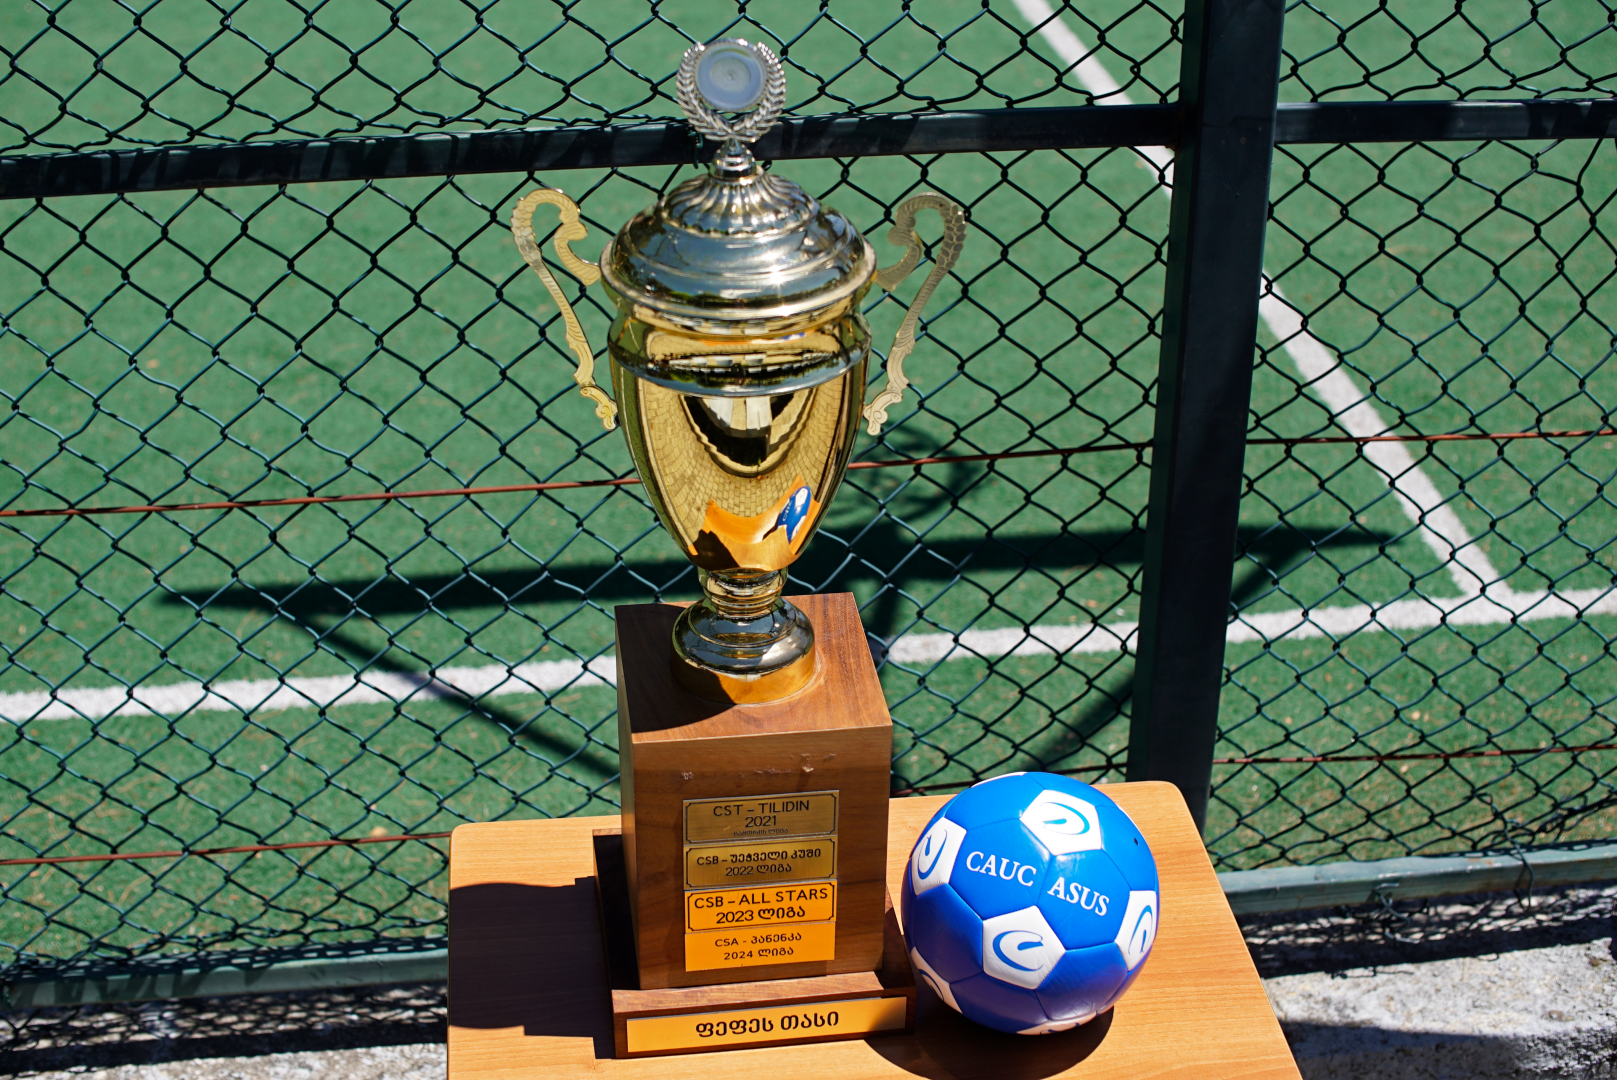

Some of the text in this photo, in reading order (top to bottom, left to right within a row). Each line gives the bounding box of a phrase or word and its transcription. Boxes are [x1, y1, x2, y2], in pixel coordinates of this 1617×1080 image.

[713, 804, 743, 816] CST
[758, 800, 810, 814] TILIDIN
[745, 815, 777, 828] 2021
[696, 856, 719, 866] CSB
[725, 863, 792, 876] 2022 ლიგა
[965, 850, 1110, 917] CAUC ASUS
[694, 896, 724, 909] CSB
[738, 892, 771, 905] ALL
[775, 888, 828, 902] STARS
[716, 906, 806, 924] 2023 ლიგა
[714, 938, 739, 947] CSA
[751, 932, 802, 944] პანენკა
[724, 947, 794, 960] 2024 ლიგა
[695, 1011, 840, 1038] ფეფეს თასი
